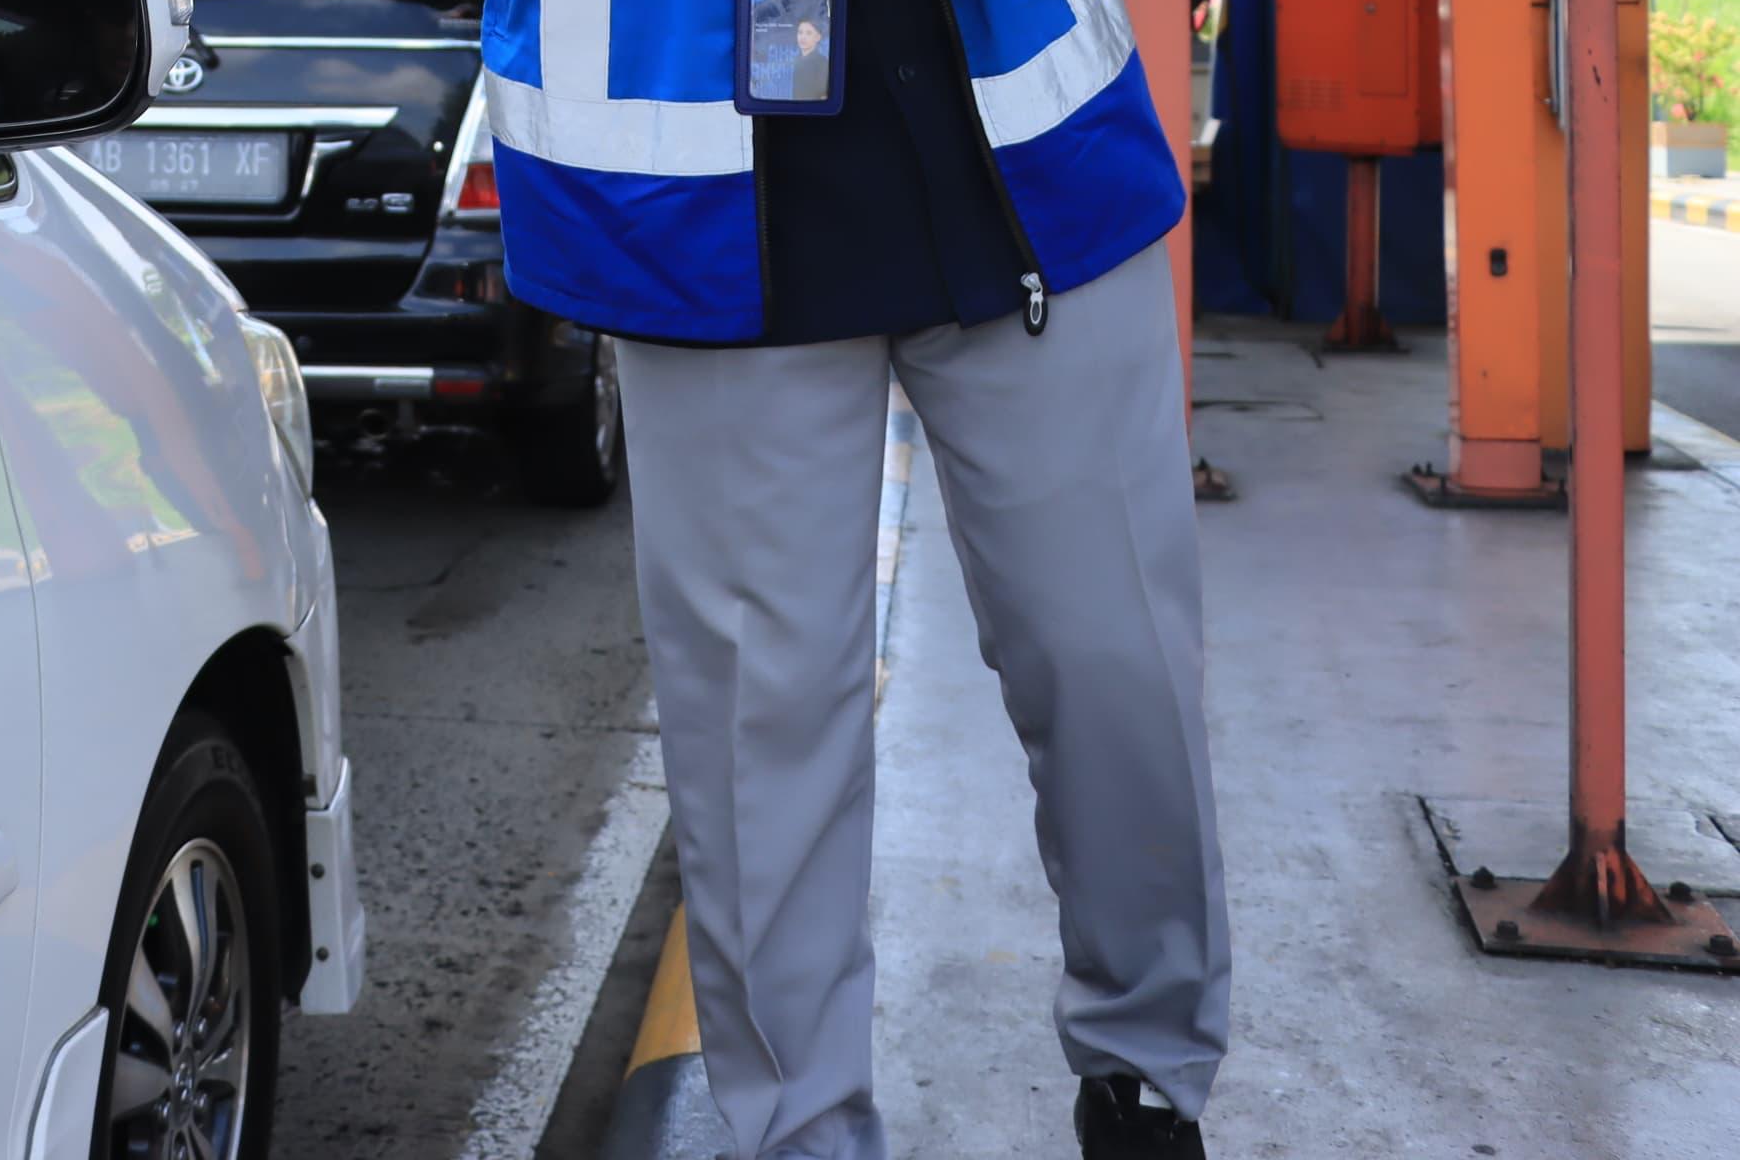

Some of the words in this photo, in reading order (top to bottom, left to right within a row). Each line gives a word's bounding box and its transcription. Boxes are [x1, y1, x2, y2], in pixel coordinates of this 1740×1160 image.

[90, 139, 123, 174] AB
[146, 140, 211, 176] 1361
[235, 141, 270, 176] XF
